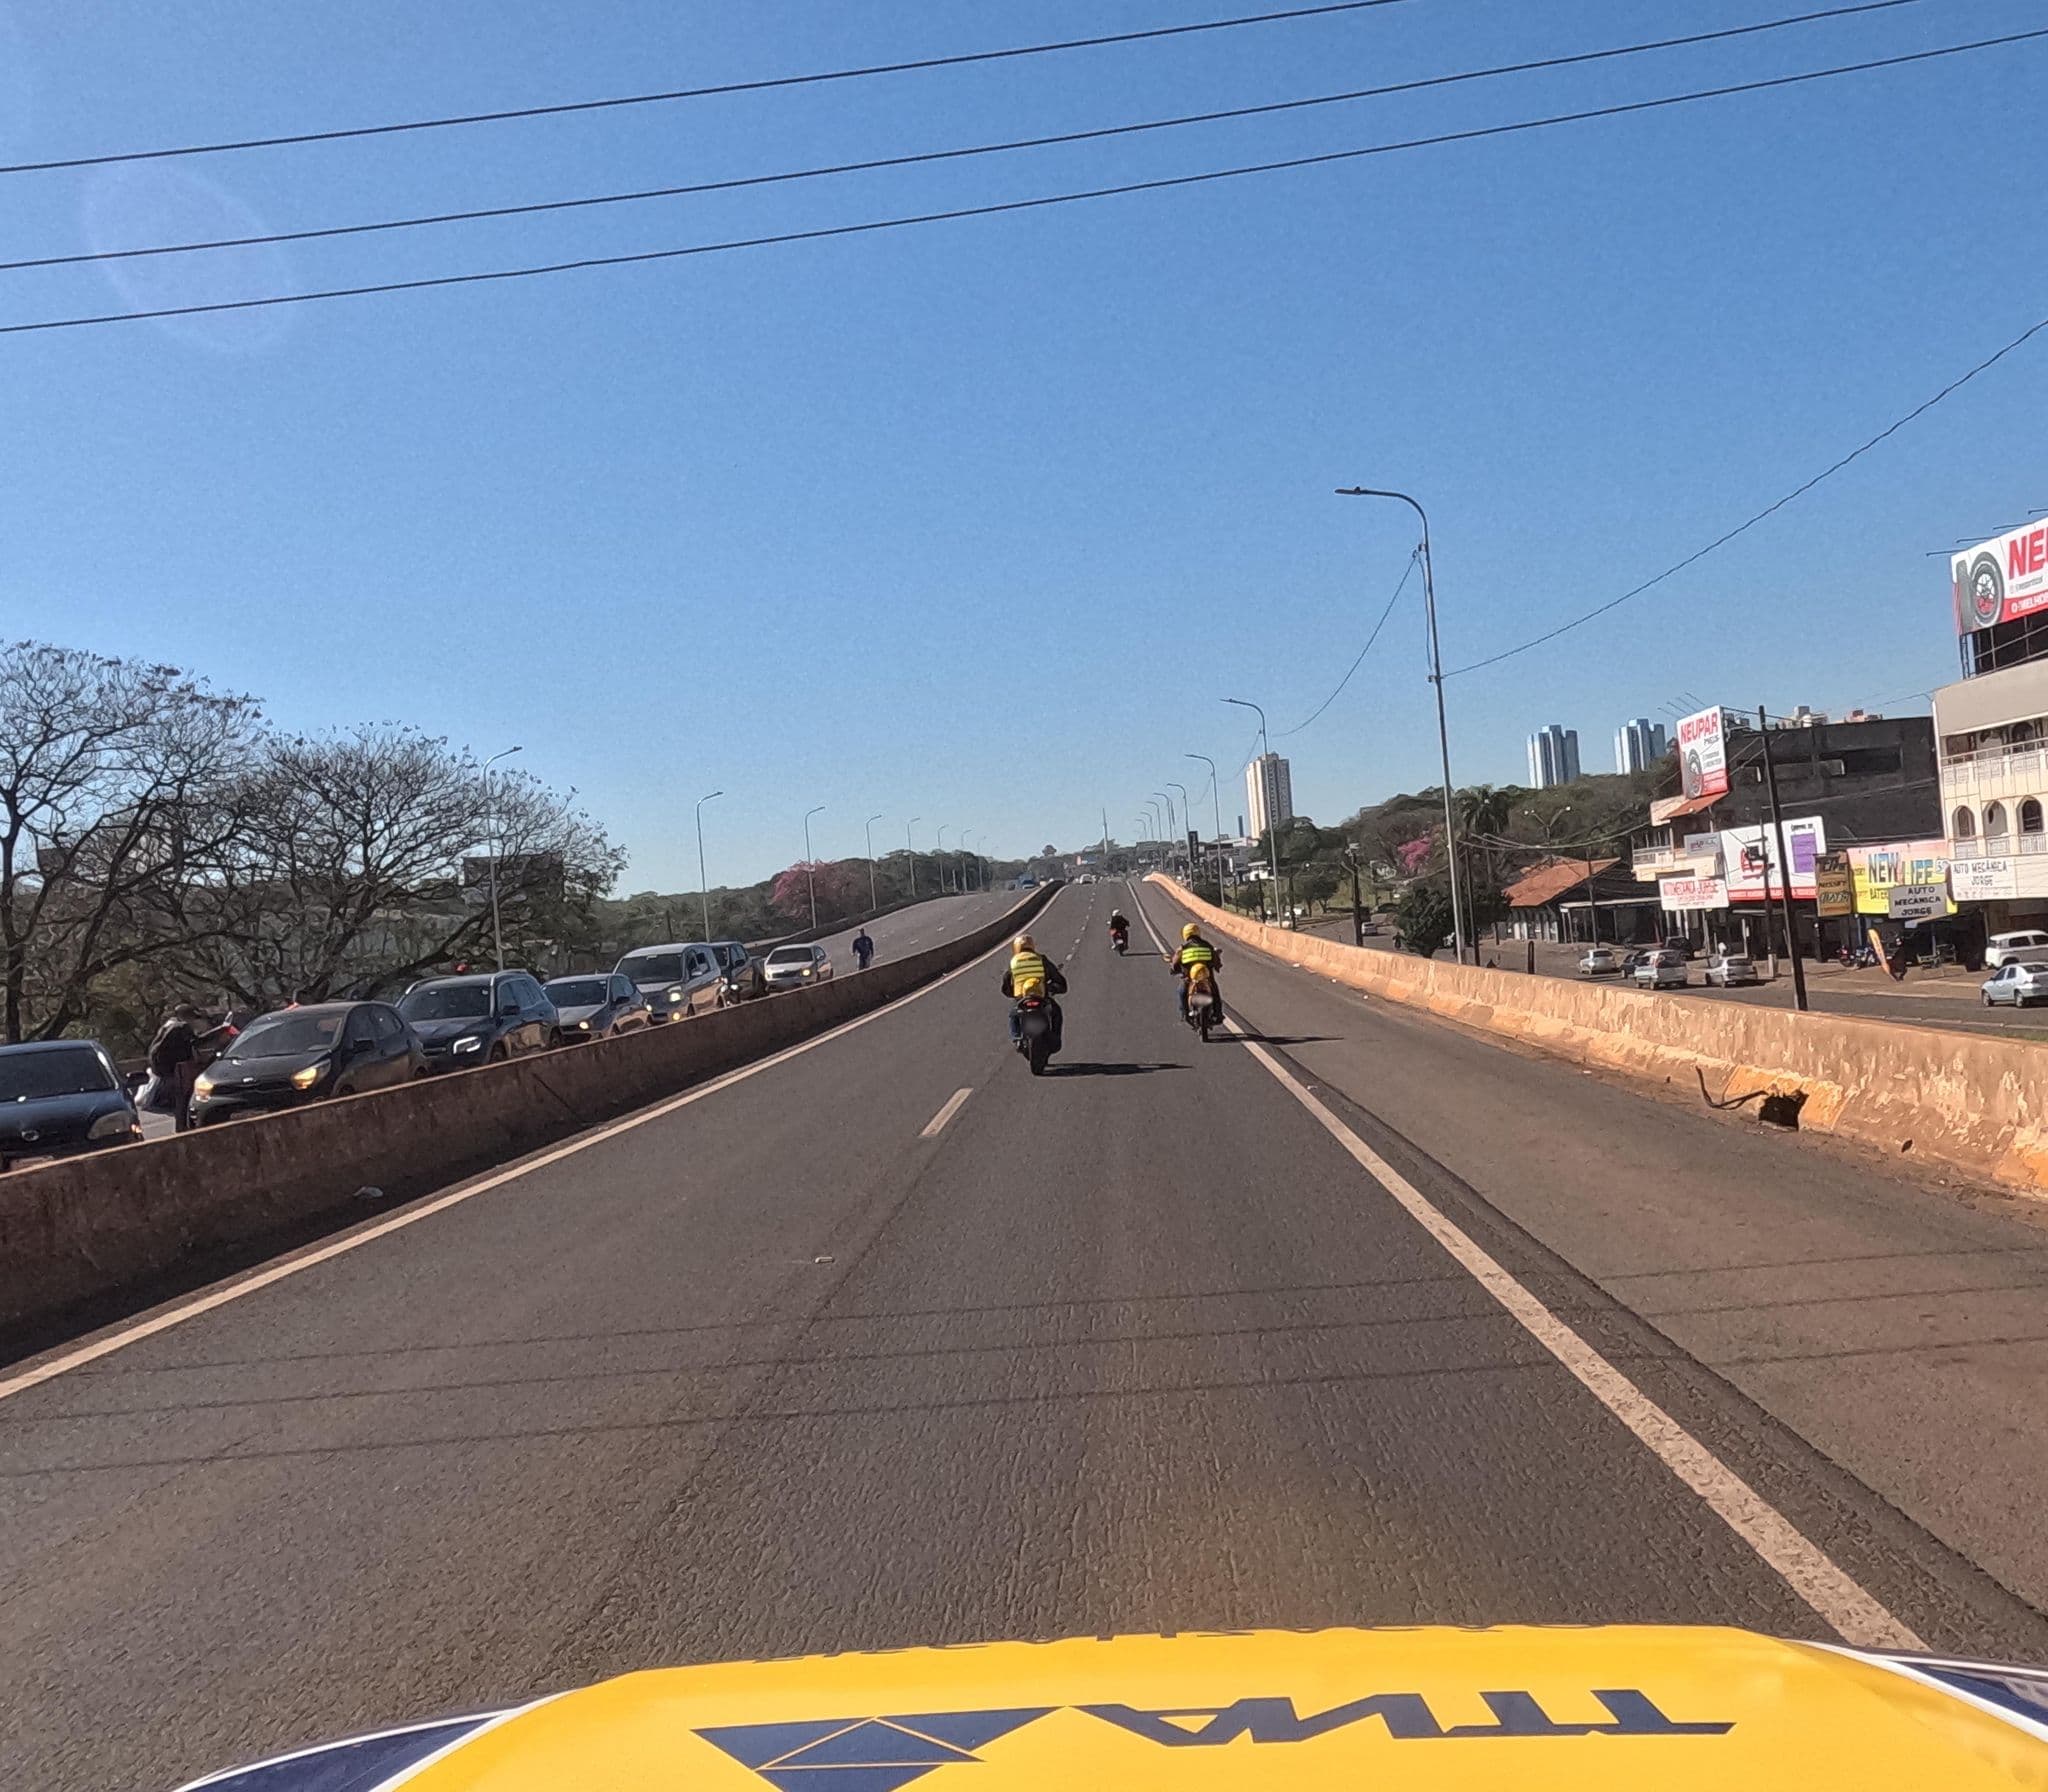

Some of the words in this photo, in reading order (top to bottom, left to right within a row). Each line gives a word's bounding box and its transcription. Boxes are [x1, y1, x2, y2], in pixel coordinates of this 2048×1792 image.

[2009, 526, 2048, 580] NE
[1681, 712, 1718, 744] NEUPAR
[1868, 852, 1898, 884] NEW
[1908, 886, 1935, 894] AUTO
[1901, 907, 1932, 916] JORGE
